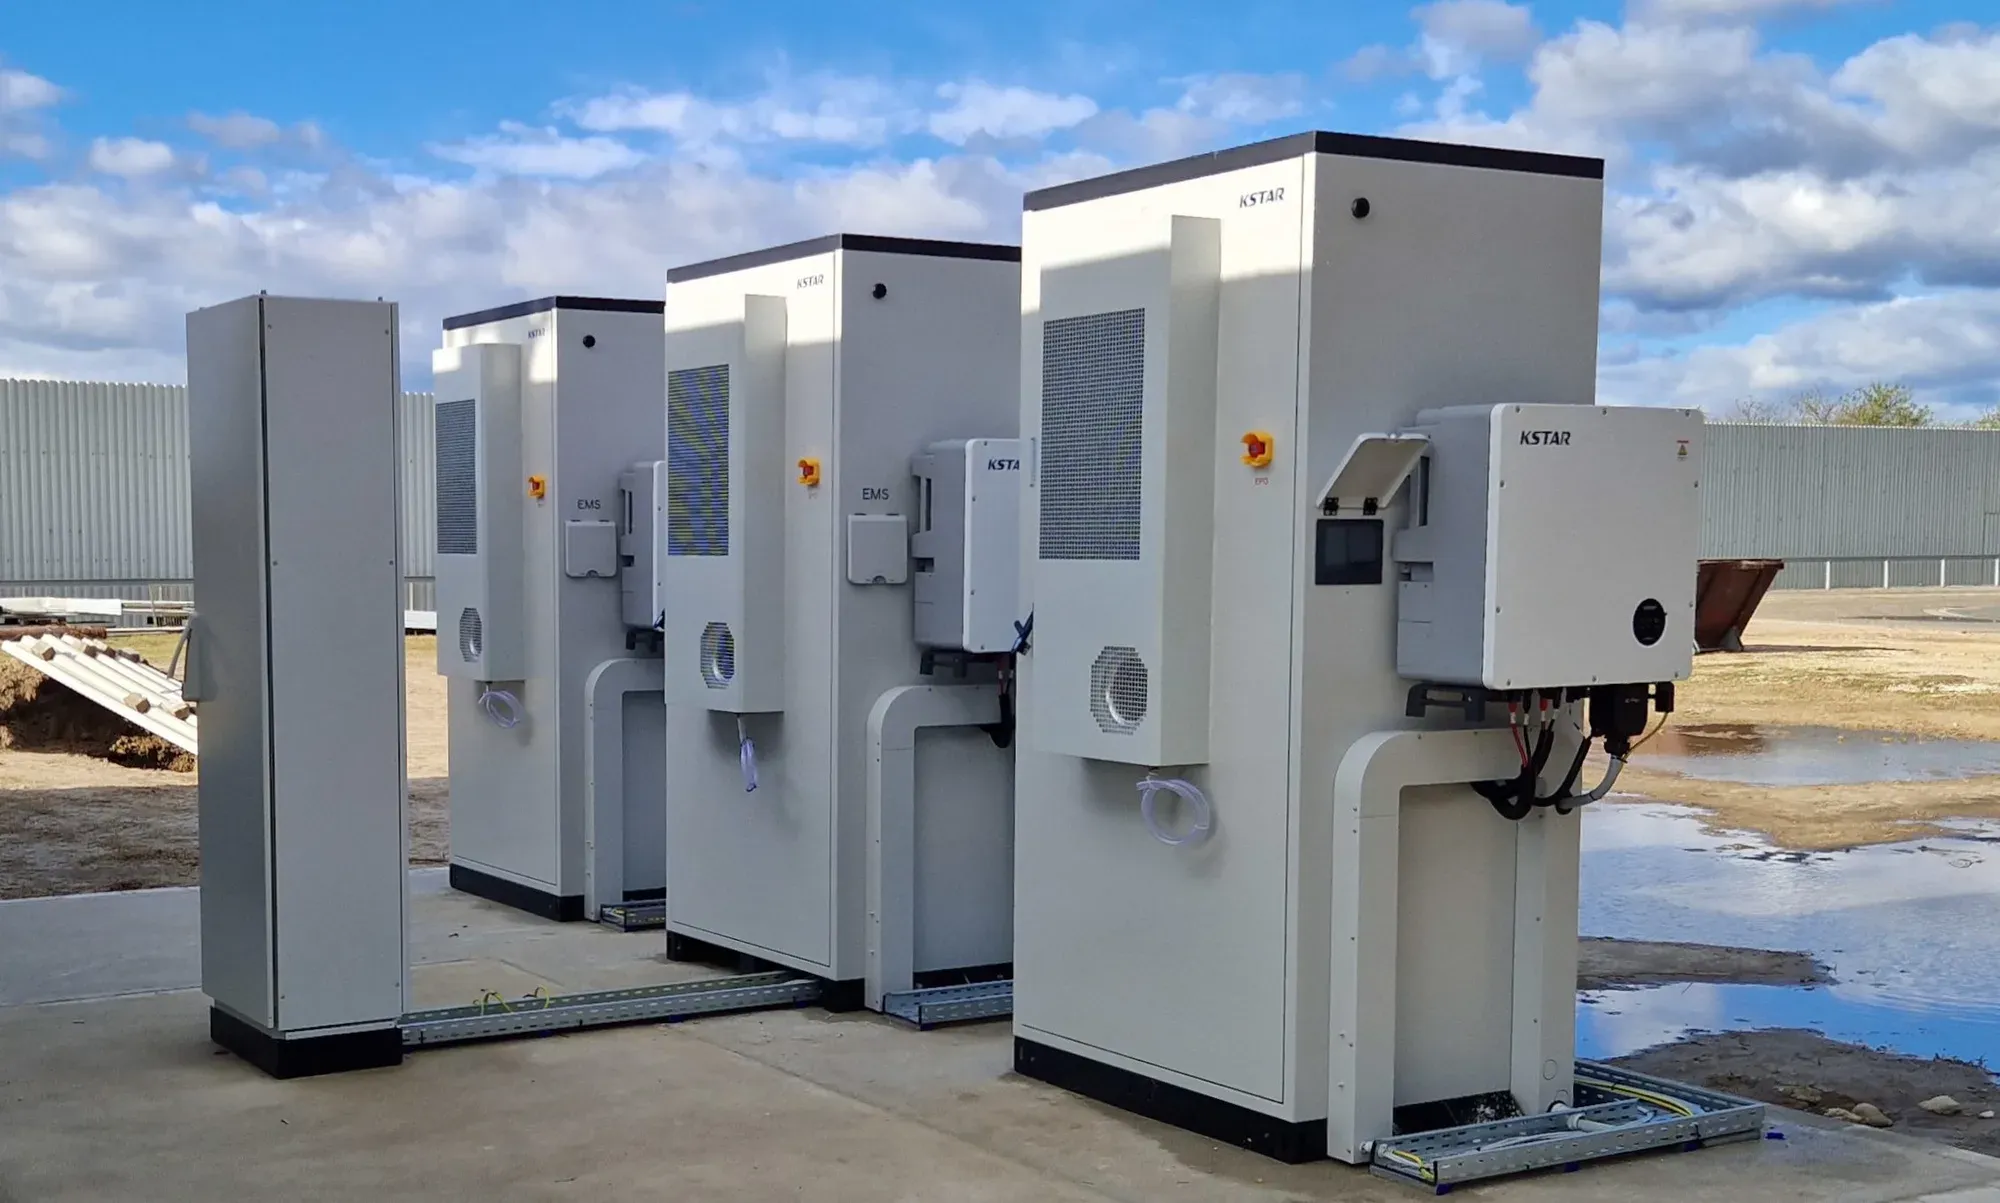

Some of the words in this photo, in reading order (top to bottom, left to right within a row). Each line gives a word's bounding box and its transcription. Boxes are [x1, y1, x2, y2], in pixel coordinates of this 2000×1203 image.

[1240, 187, 1285, 208] KSTAR
[797, 274, 824, 289] KSTAR
[1520, 430, 1571, 446] KSTAR
[862, 487, 889, 500] EMS
[577, 499, 601, 510] EMS
